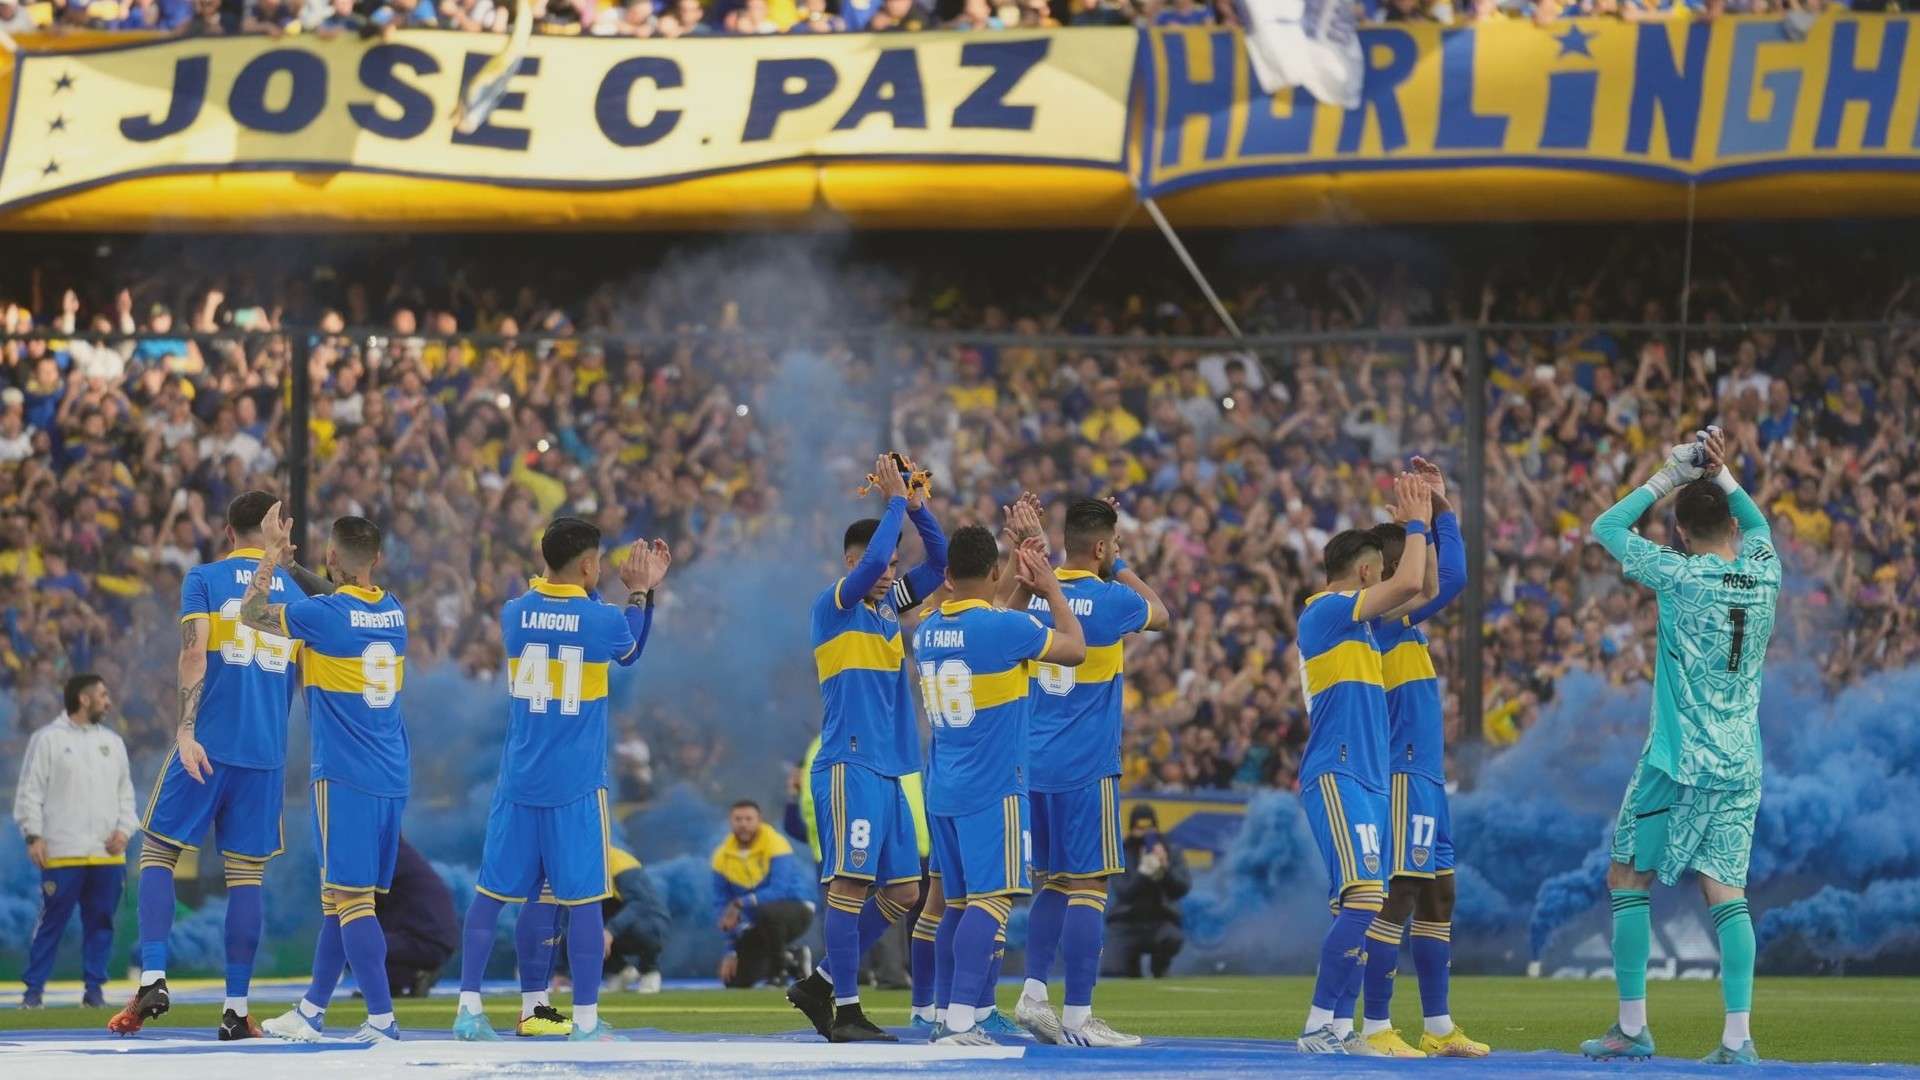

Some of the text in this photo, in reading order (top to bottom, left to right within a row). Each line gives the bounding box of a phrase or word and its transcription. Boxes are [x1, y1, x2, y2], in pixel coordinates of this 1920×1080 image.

[119, 43, 541, 151] JOSE
[740, 37, 1053, 143] PAZ
[1723, 573, 1757, 589] ROSSI
[1027, 593, 1093, 616] ZAMANO
[521, 610, 580, 632] LANGONI
[925, 630, 965, 648] F. FABRA
[1728, 607, 1748, 673] 1
[361, 641, 397, 709] 9
[512, 642, 584, 716] 41
[917, 659, 976, 728] 18
[850, 818, 871, 849] 8
[1354, 823, 1380, 855] 10
[1412, 814, 1435, 847] 17
